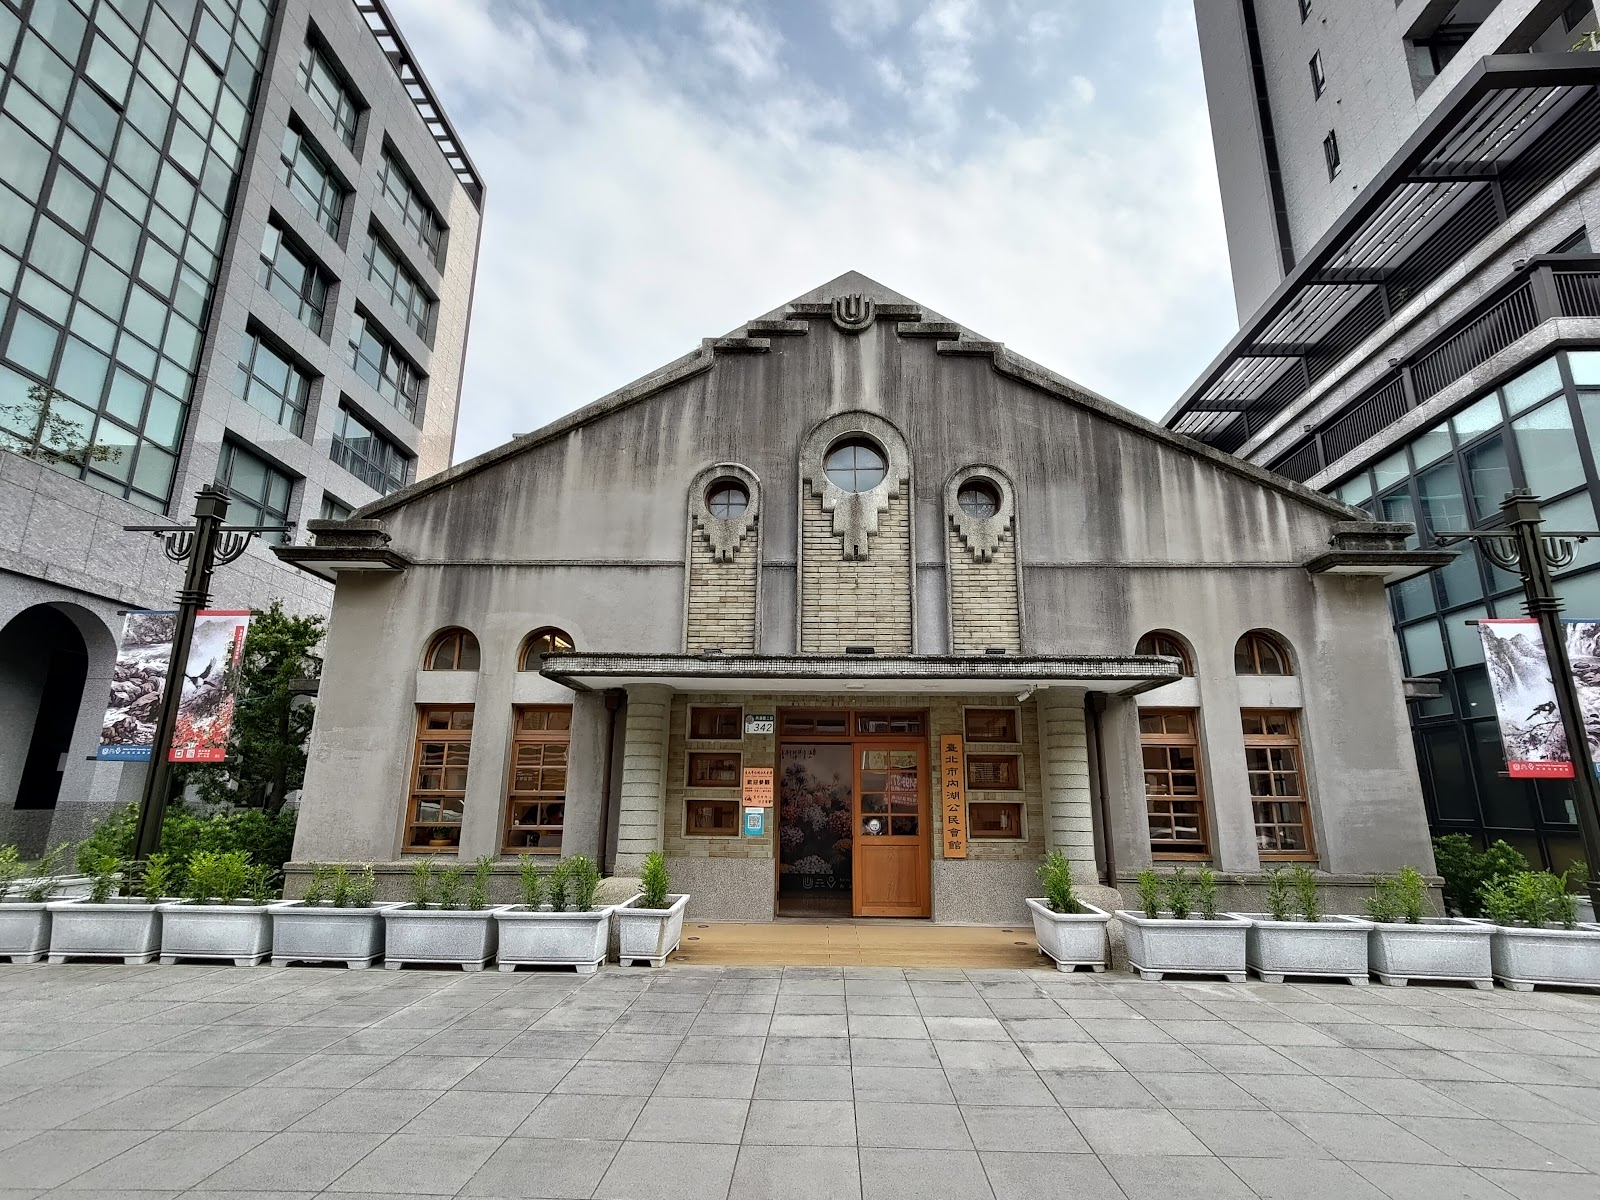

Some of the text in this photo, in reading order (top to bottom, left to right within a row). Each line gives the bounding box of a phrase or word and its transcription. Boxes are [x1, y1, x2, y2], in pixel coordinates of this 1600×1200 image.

[753, 723, 772, 732] 342
[945, 743, 962, 850] 臺北市內湖公民會館
